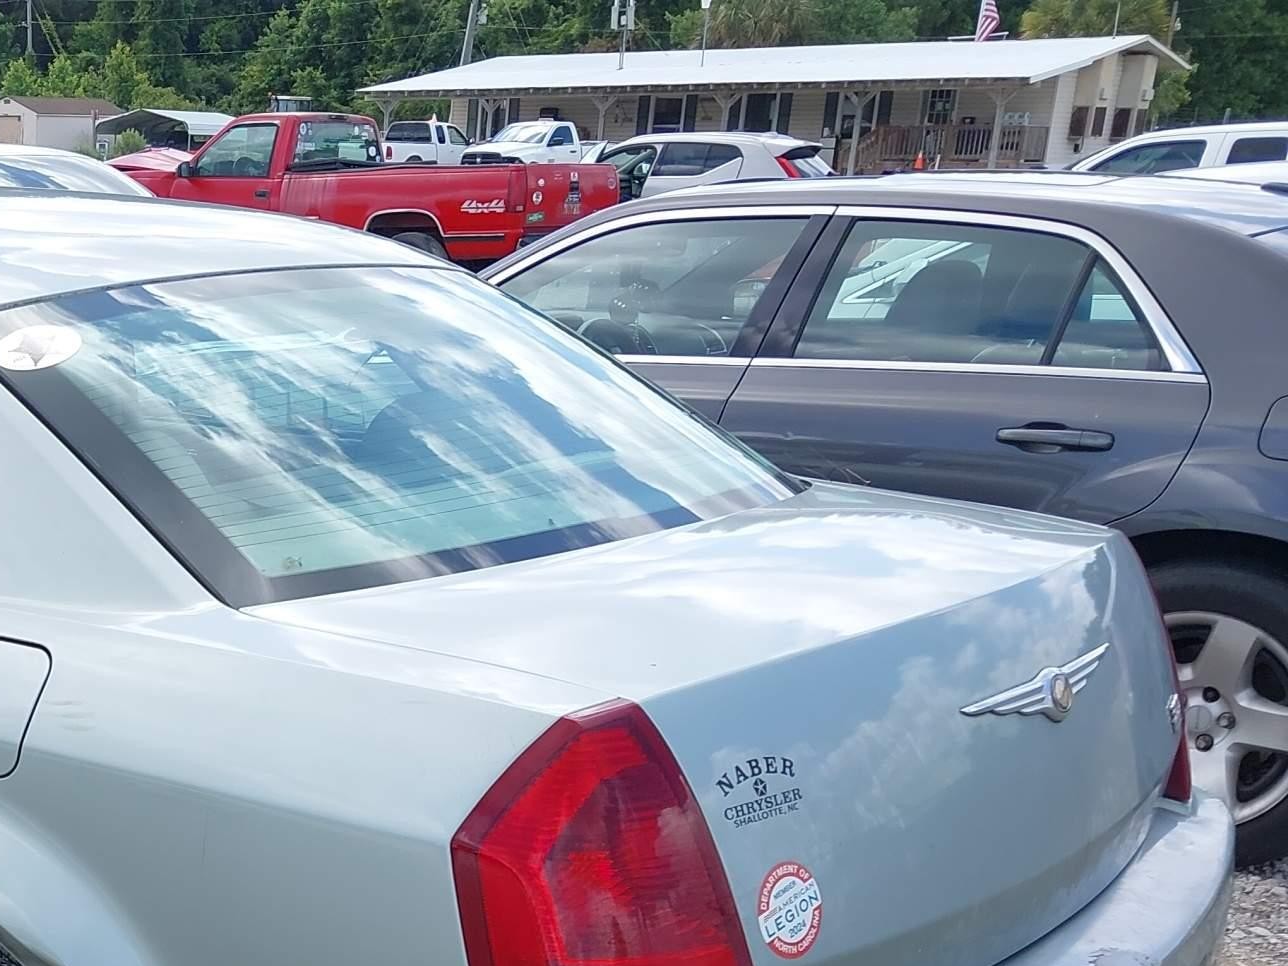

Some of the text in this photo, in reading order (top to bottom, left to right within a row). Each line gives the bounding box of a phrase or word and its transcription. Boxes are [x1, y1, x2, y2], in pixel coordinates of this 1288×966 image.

[715, 756, 795, 797] NABER
[724, 788, 803, 821] CHRYSLER
[733, 802, 800, 829] SHALLOTTE, NC
[760, 865, 810, 910] DEPARTMENT OF
[778, 880, 815, 912] AMERICAN
[764, 890, 819, 938] LEGION
[773, 908, 821, 954] NORTH CAROLINA
[788, 919, 807, 938] 2024
